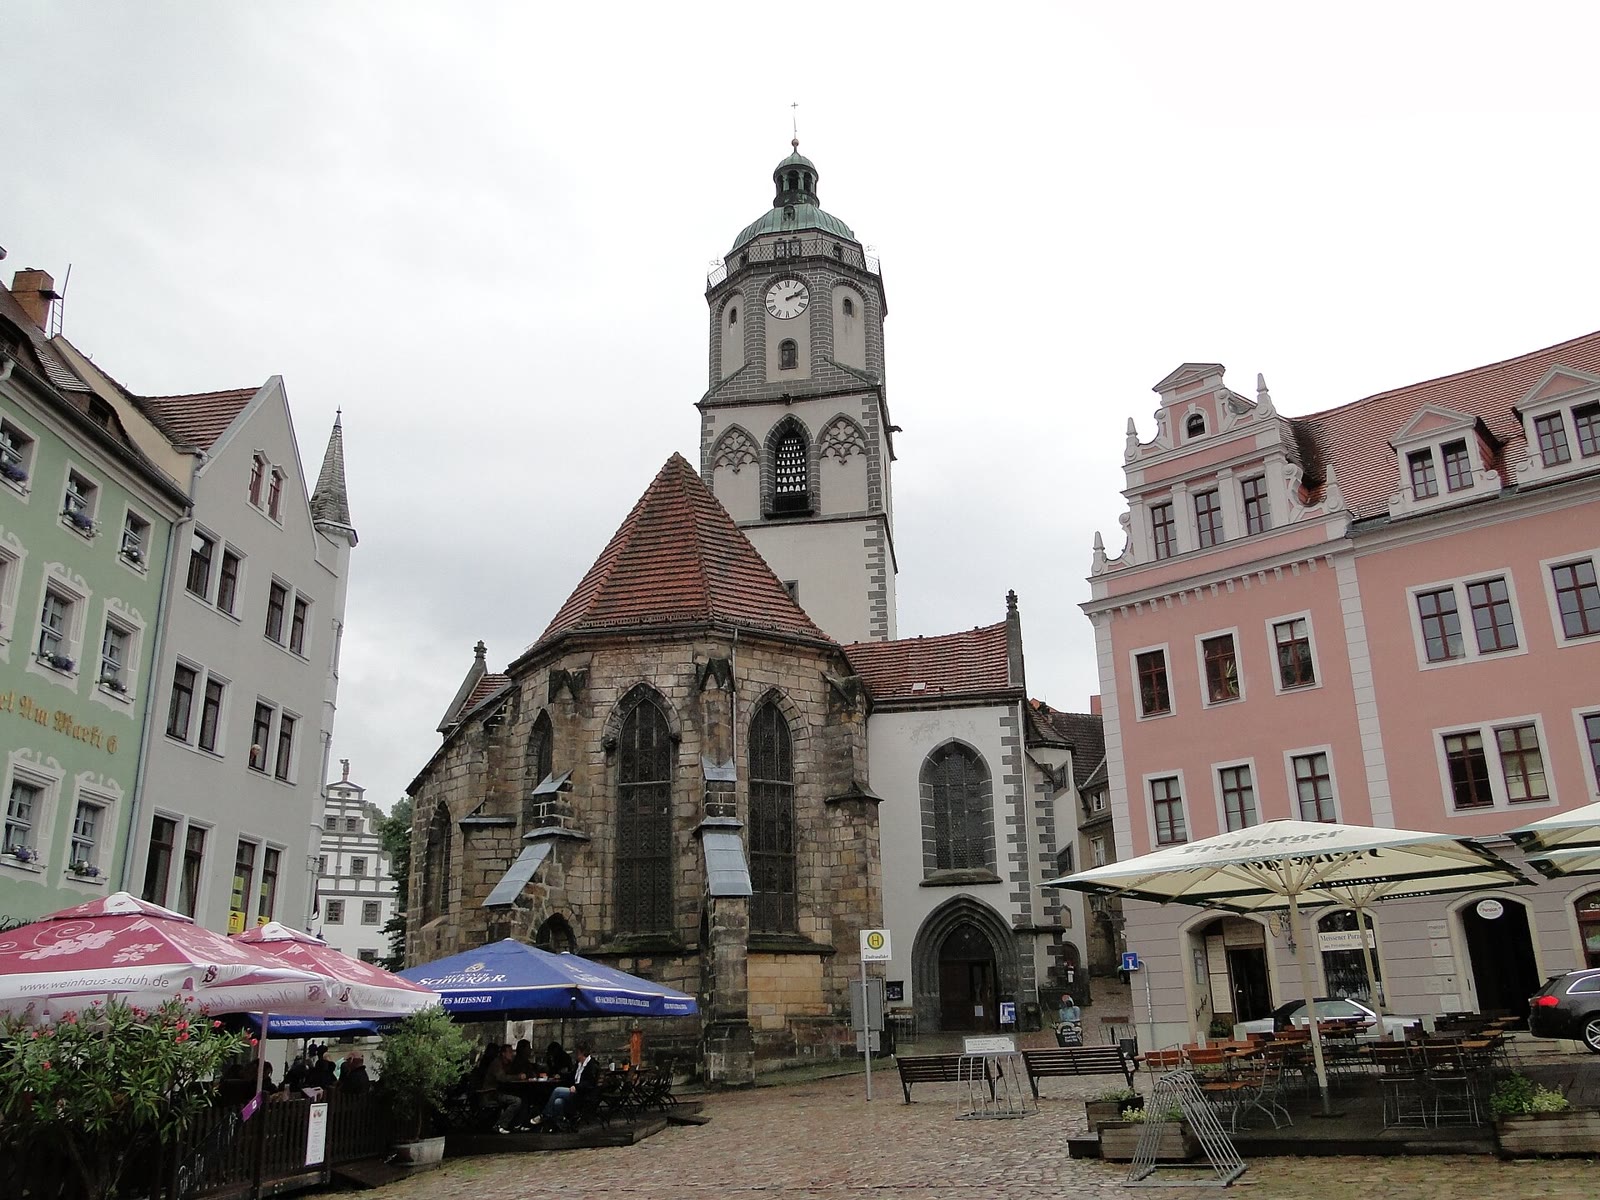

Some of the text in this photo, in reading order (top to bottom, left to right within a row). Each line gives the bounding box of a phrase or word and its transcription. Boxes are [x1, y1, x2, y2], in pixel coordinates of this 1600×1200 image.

[19, 695, 48, 727] Am
[53, 710, 102, 749] Markt
[1180, 829, 1345, 855] Freiberger
[871, 935, 880, 945] H
[19, 975, 169, 992] www.weinhaus-schuh.de
[454, 995, 492, 1004] MEISSNER
